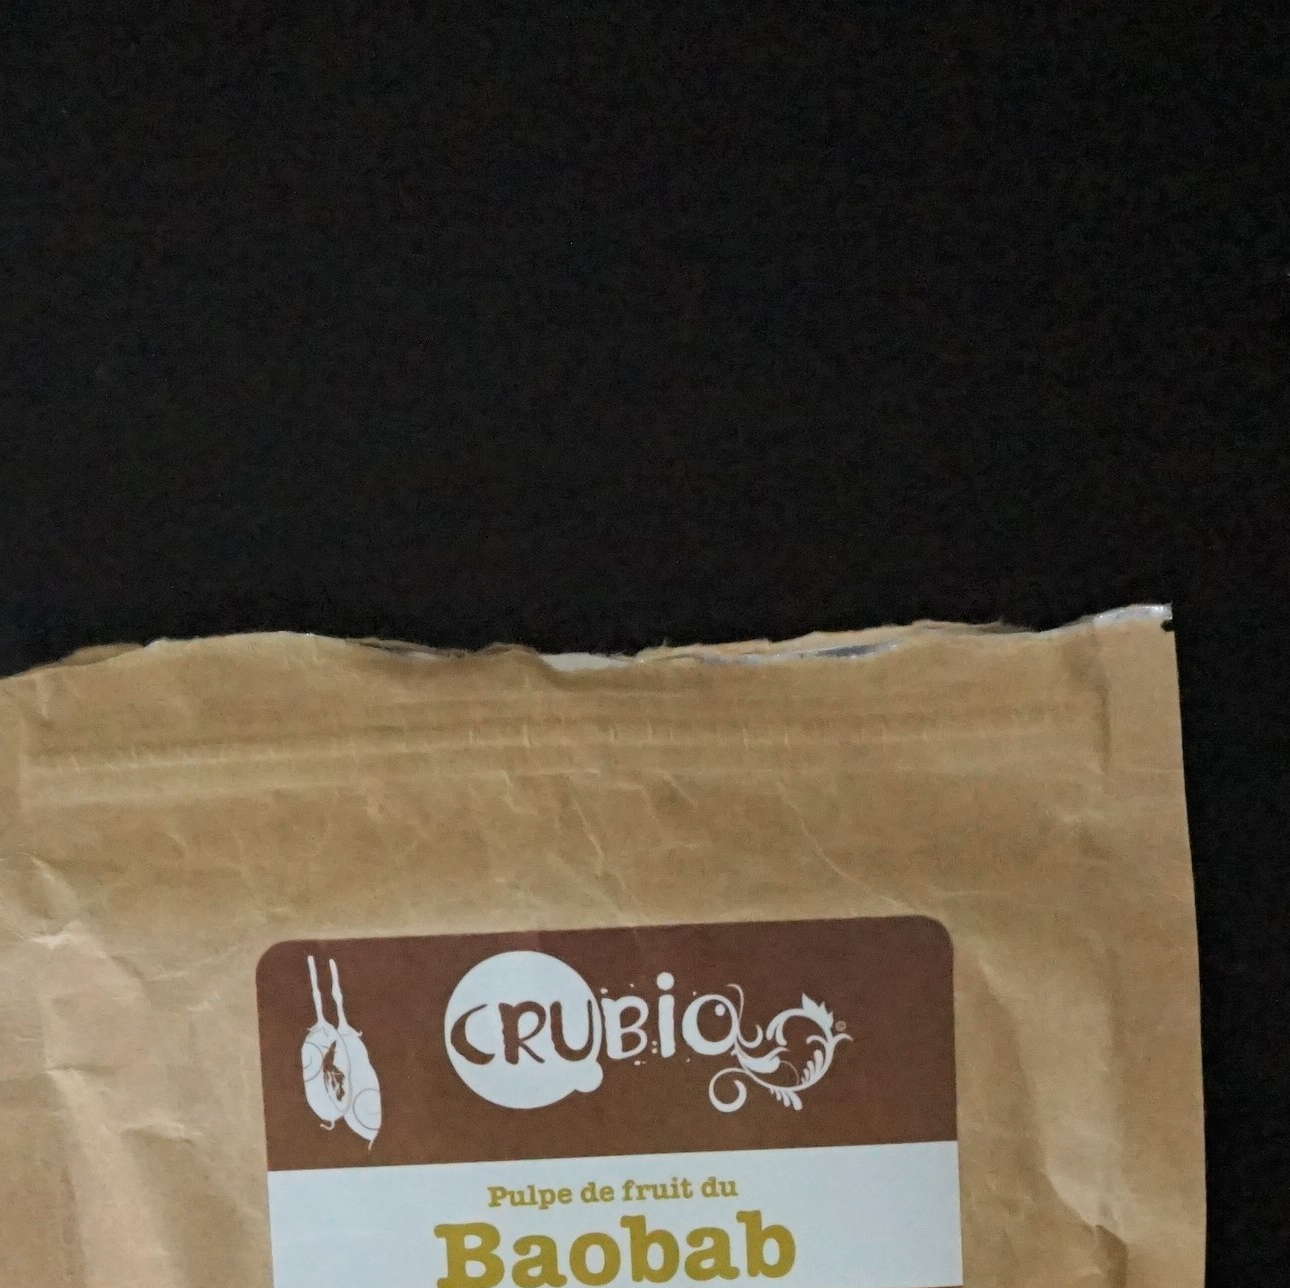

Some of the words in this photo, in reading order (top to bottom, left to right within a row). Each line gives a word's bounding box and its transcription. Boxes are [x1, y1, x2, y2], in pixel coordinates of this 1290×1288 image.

[447, 971, 743, 1066] CRUBIO
[487, 1184, 573, 1209] Pulpe
[580, 1181, 614, 1203] de
[621, 1176, 694, 1201] fruit
[701, 1176, 738, 1197] du
